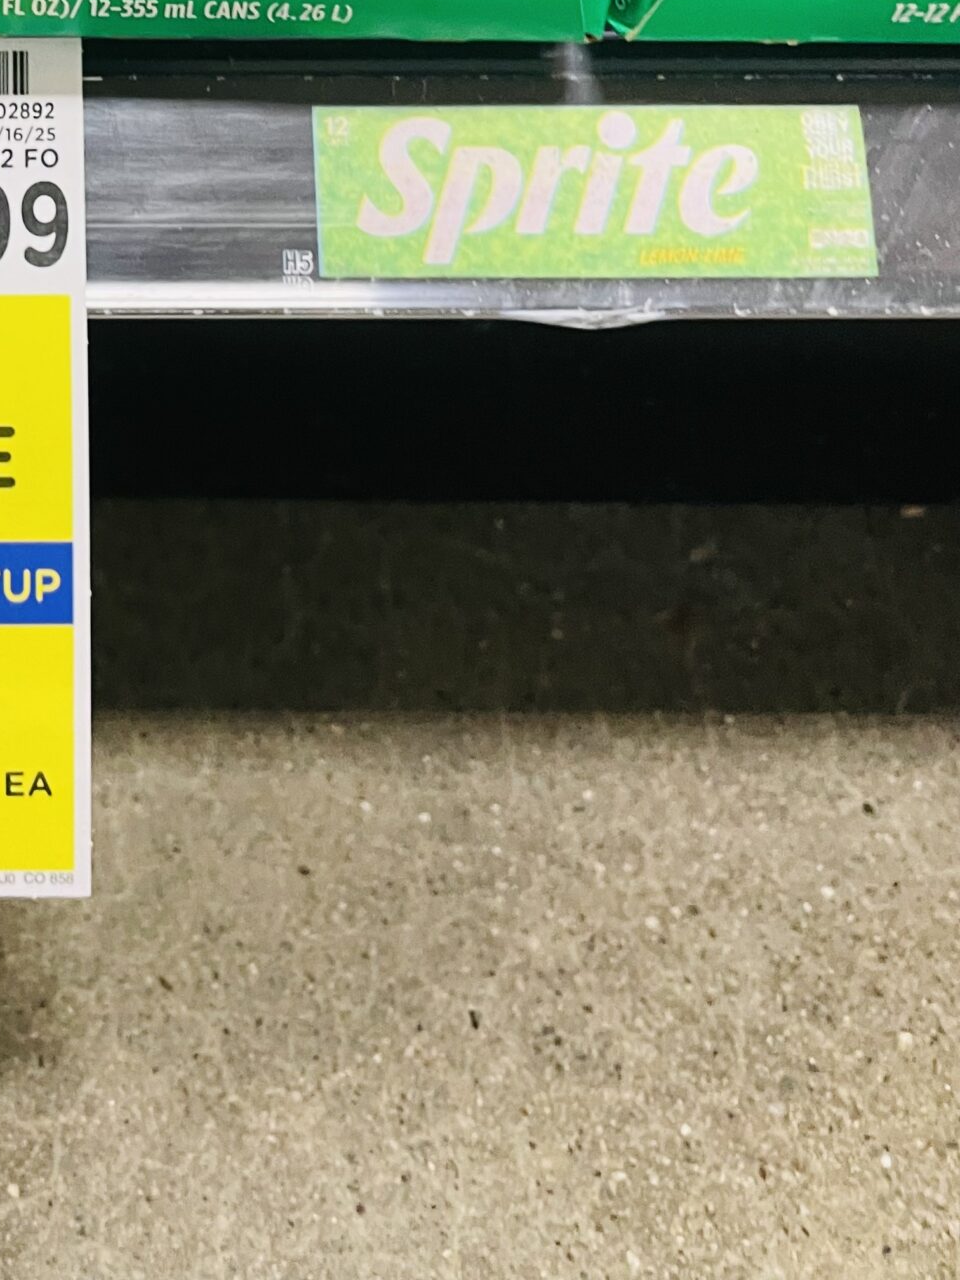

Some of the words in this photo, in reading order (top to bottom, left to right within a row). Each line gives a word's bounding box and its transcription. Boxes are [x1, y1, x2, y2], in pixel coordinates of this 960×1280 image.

[203, 0, 261, 21] CANS
[891, 2, 950, 24] 12-12
[24, 148, 59, 168] FO
[356, 111, 758, 264] Sprite
[5, 772, 53, 797] EA
[23, 872, 46, 885] CO
